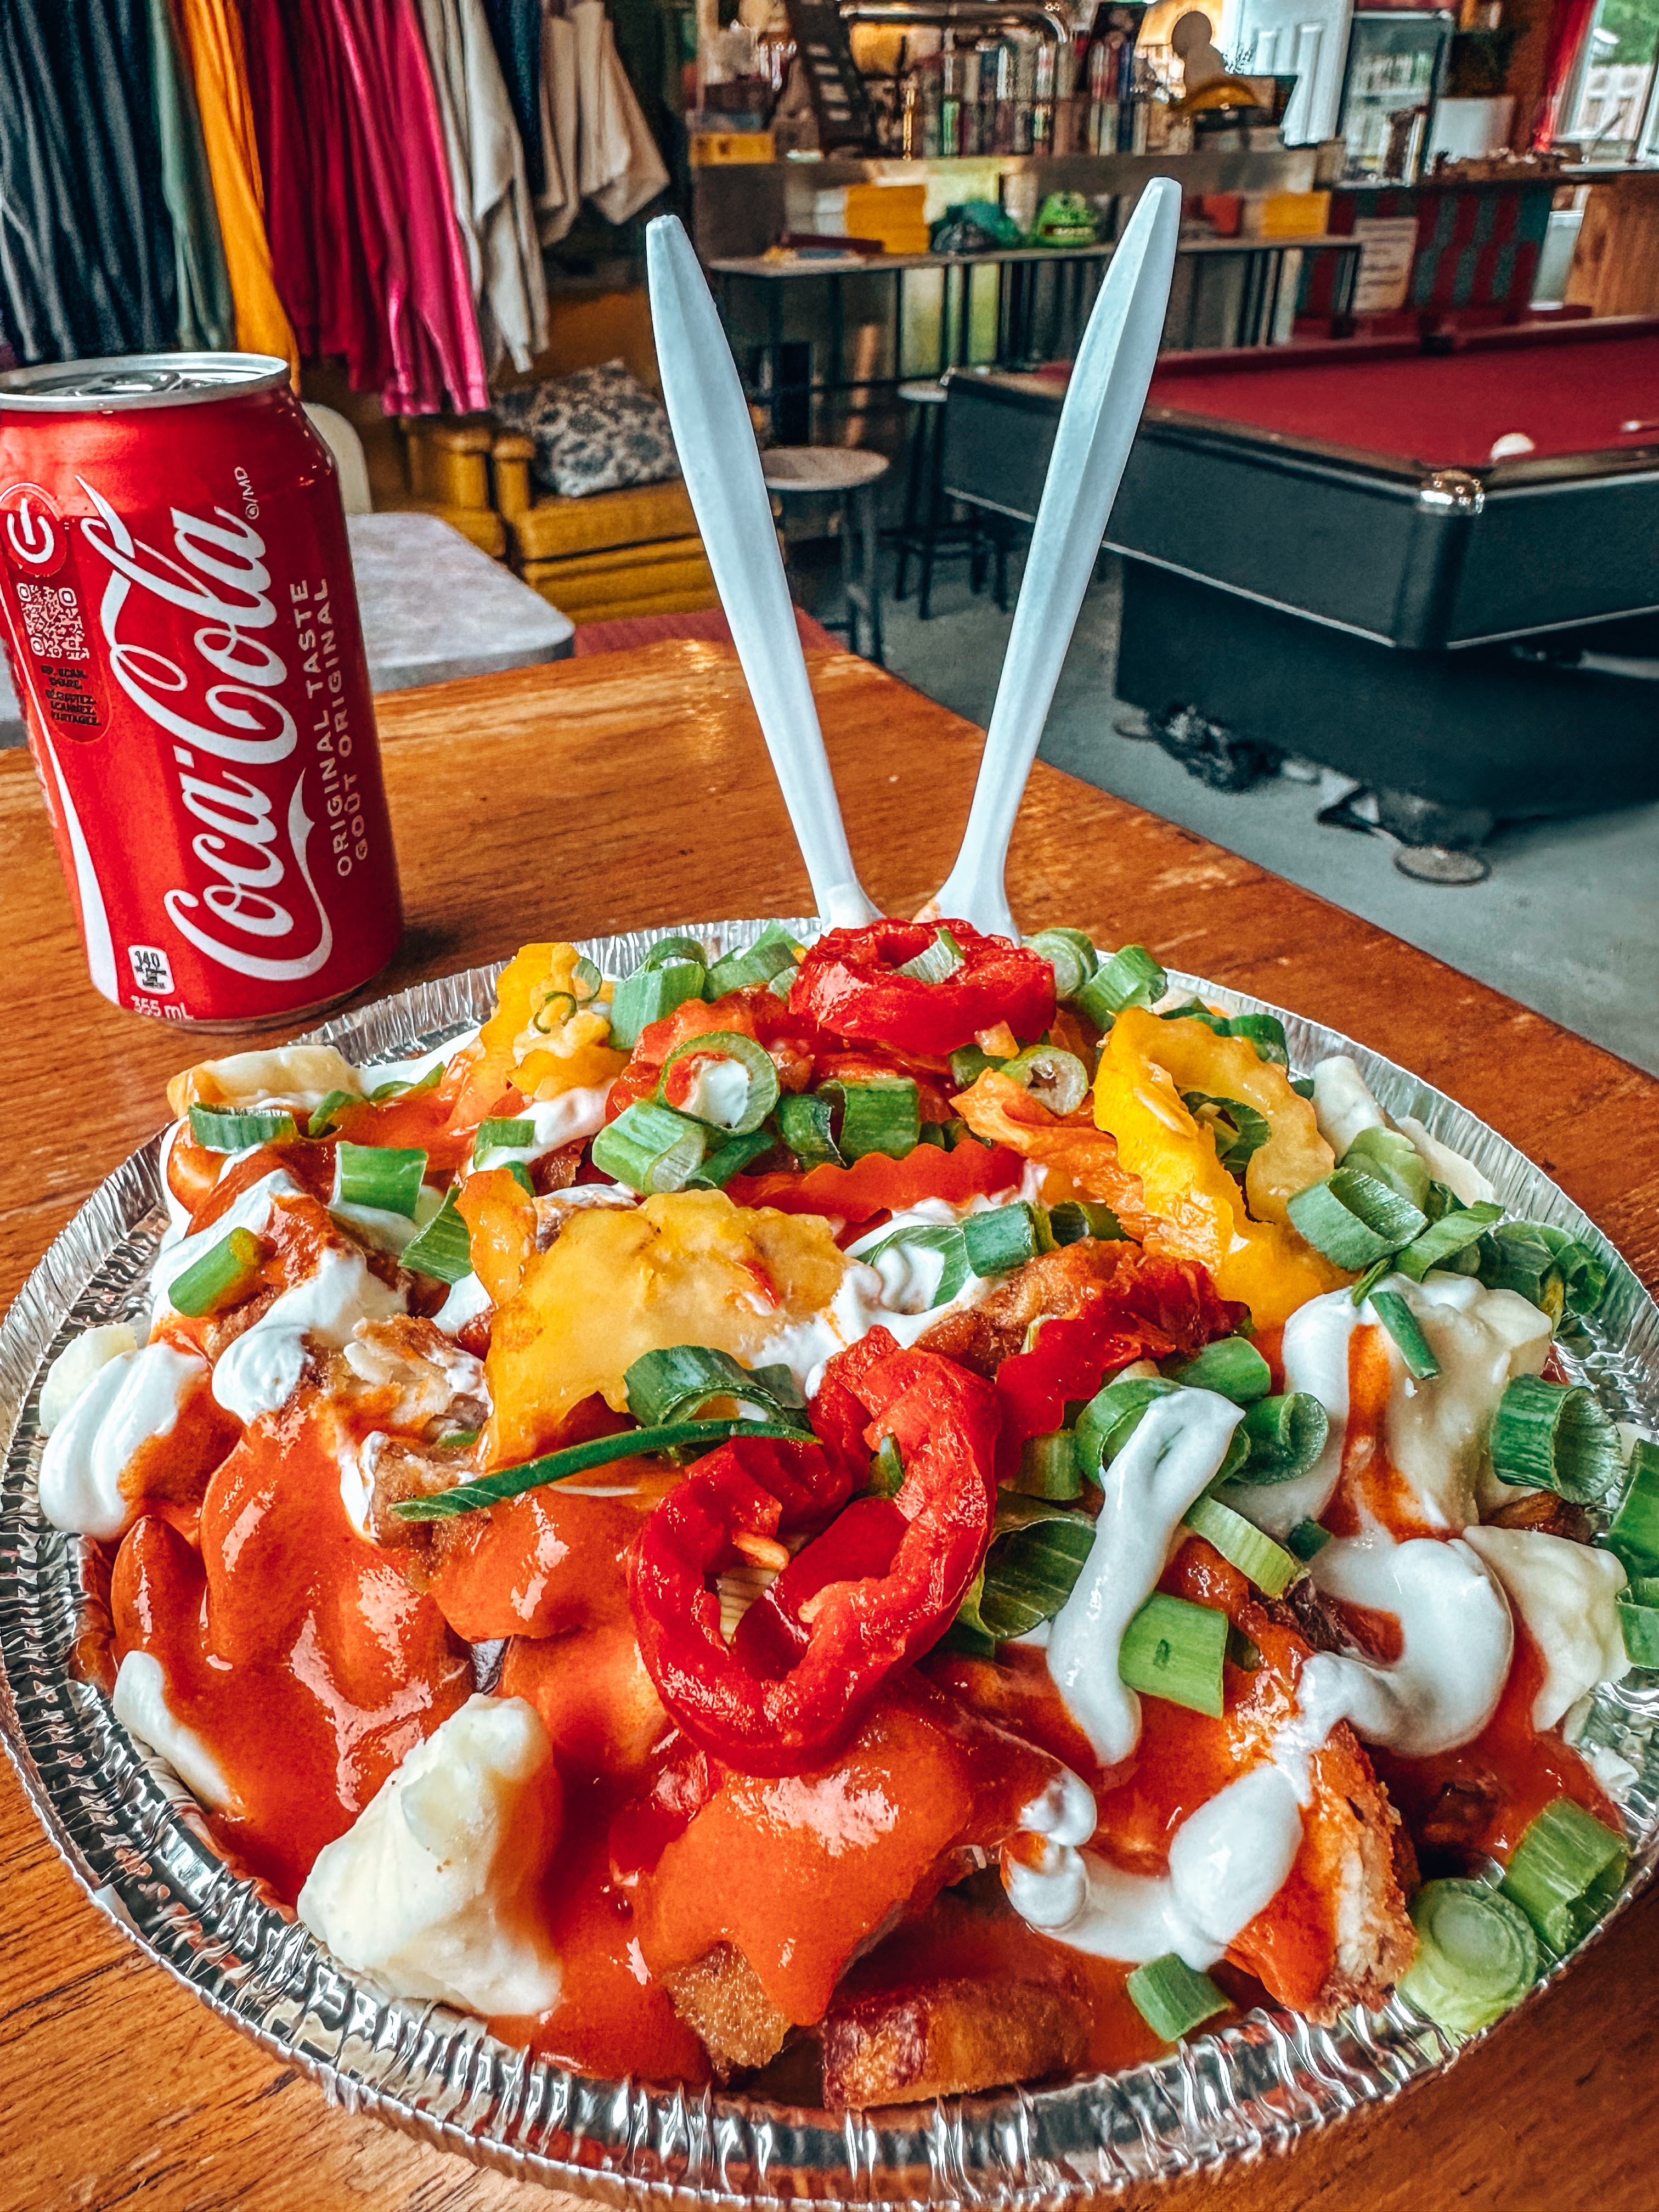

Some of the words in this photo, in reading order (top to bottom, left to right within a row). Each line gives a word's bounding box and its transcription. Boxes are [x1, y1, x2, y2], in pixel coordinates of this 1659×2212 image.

[289, 580, 324, 699] TASTE
[313, 578, 352, 758] ORIGINAL
[75, 474, 333, 981] Coca-Cola
[313, 709, 353, 877] ORIGINAL
[163, 1002, 194, 1020] mL
